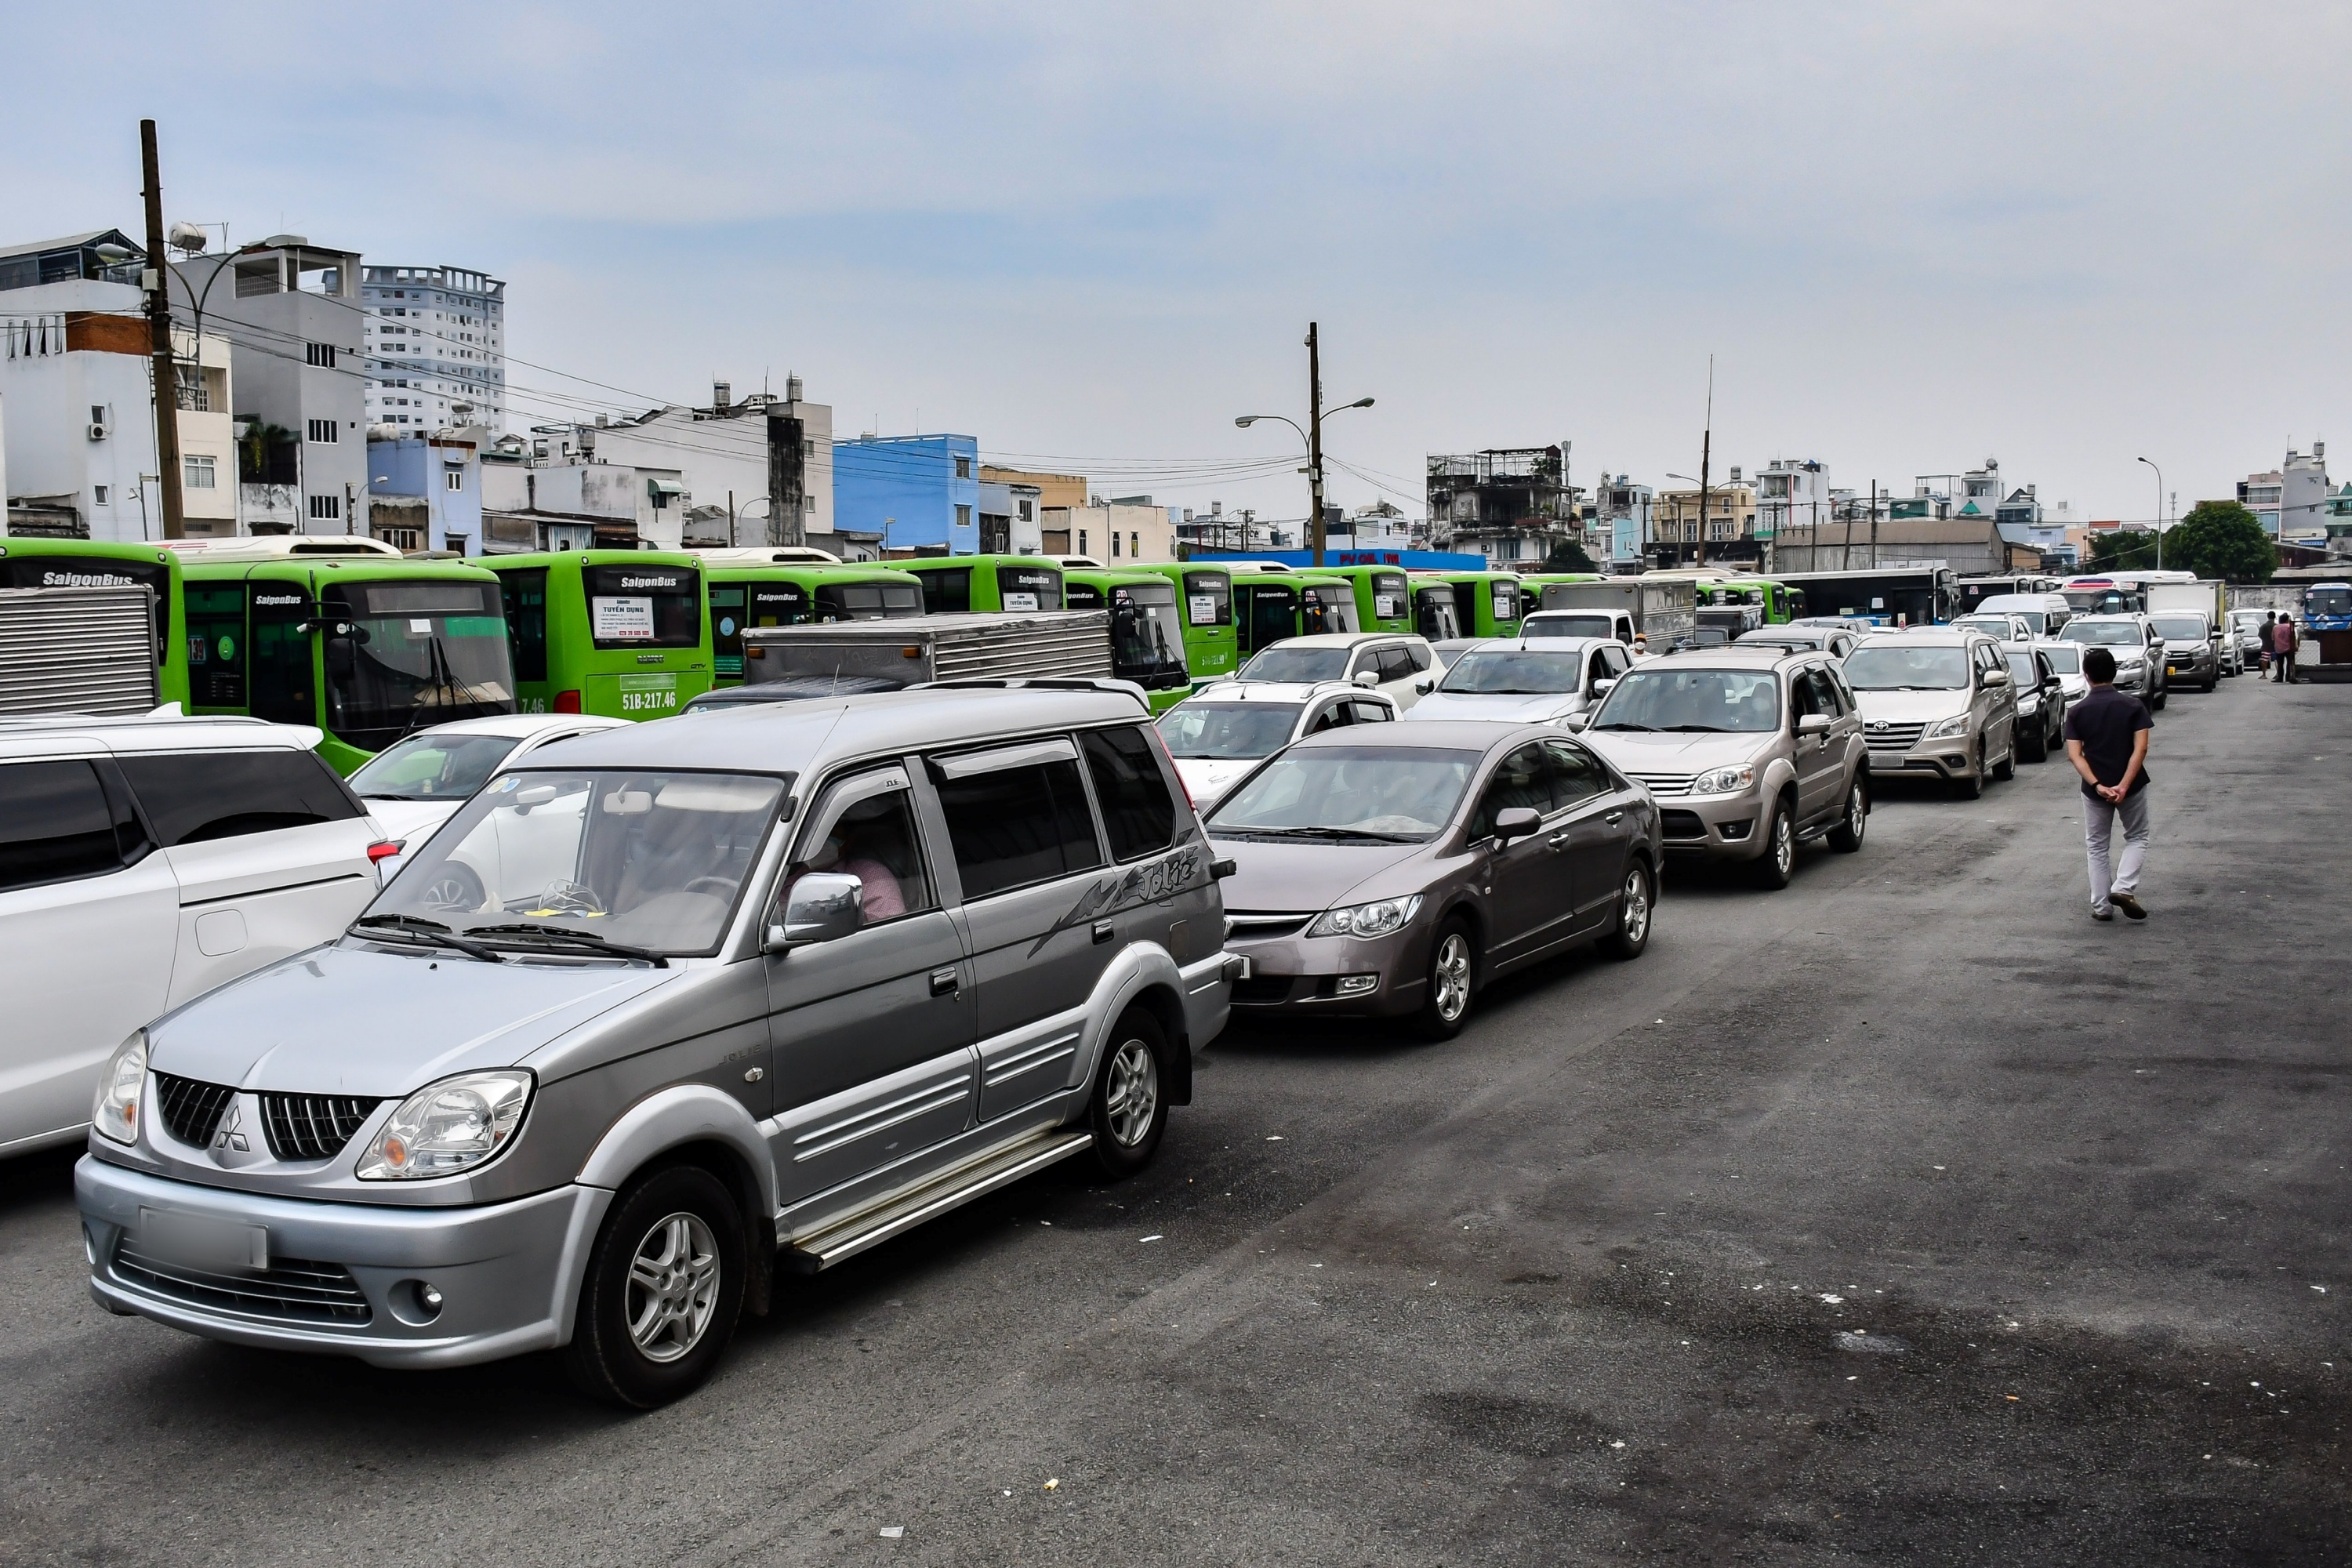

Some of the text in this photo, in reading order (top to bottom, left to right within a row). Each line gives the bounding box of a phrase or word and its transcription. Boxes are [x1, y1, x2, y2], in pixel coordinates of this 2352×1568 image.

[1340, 554, 1356, 564] PV
[1359, 553, 1377, 564] OIL
[43, 572, 132, 587] SaigonBus
[621, 577, 677, 588] SaigonBus
[1018, 575, 1050, 585] SaigonBus
[256, 595, 302, 605] SaigonBus
[757, 593, 798, 602] SaigonBus
[622, 691, 676, 710] 51B-217.46
[1138, 861, 1192, 901] Jolie
[719, 1044, 761, 1065] JOLIE
